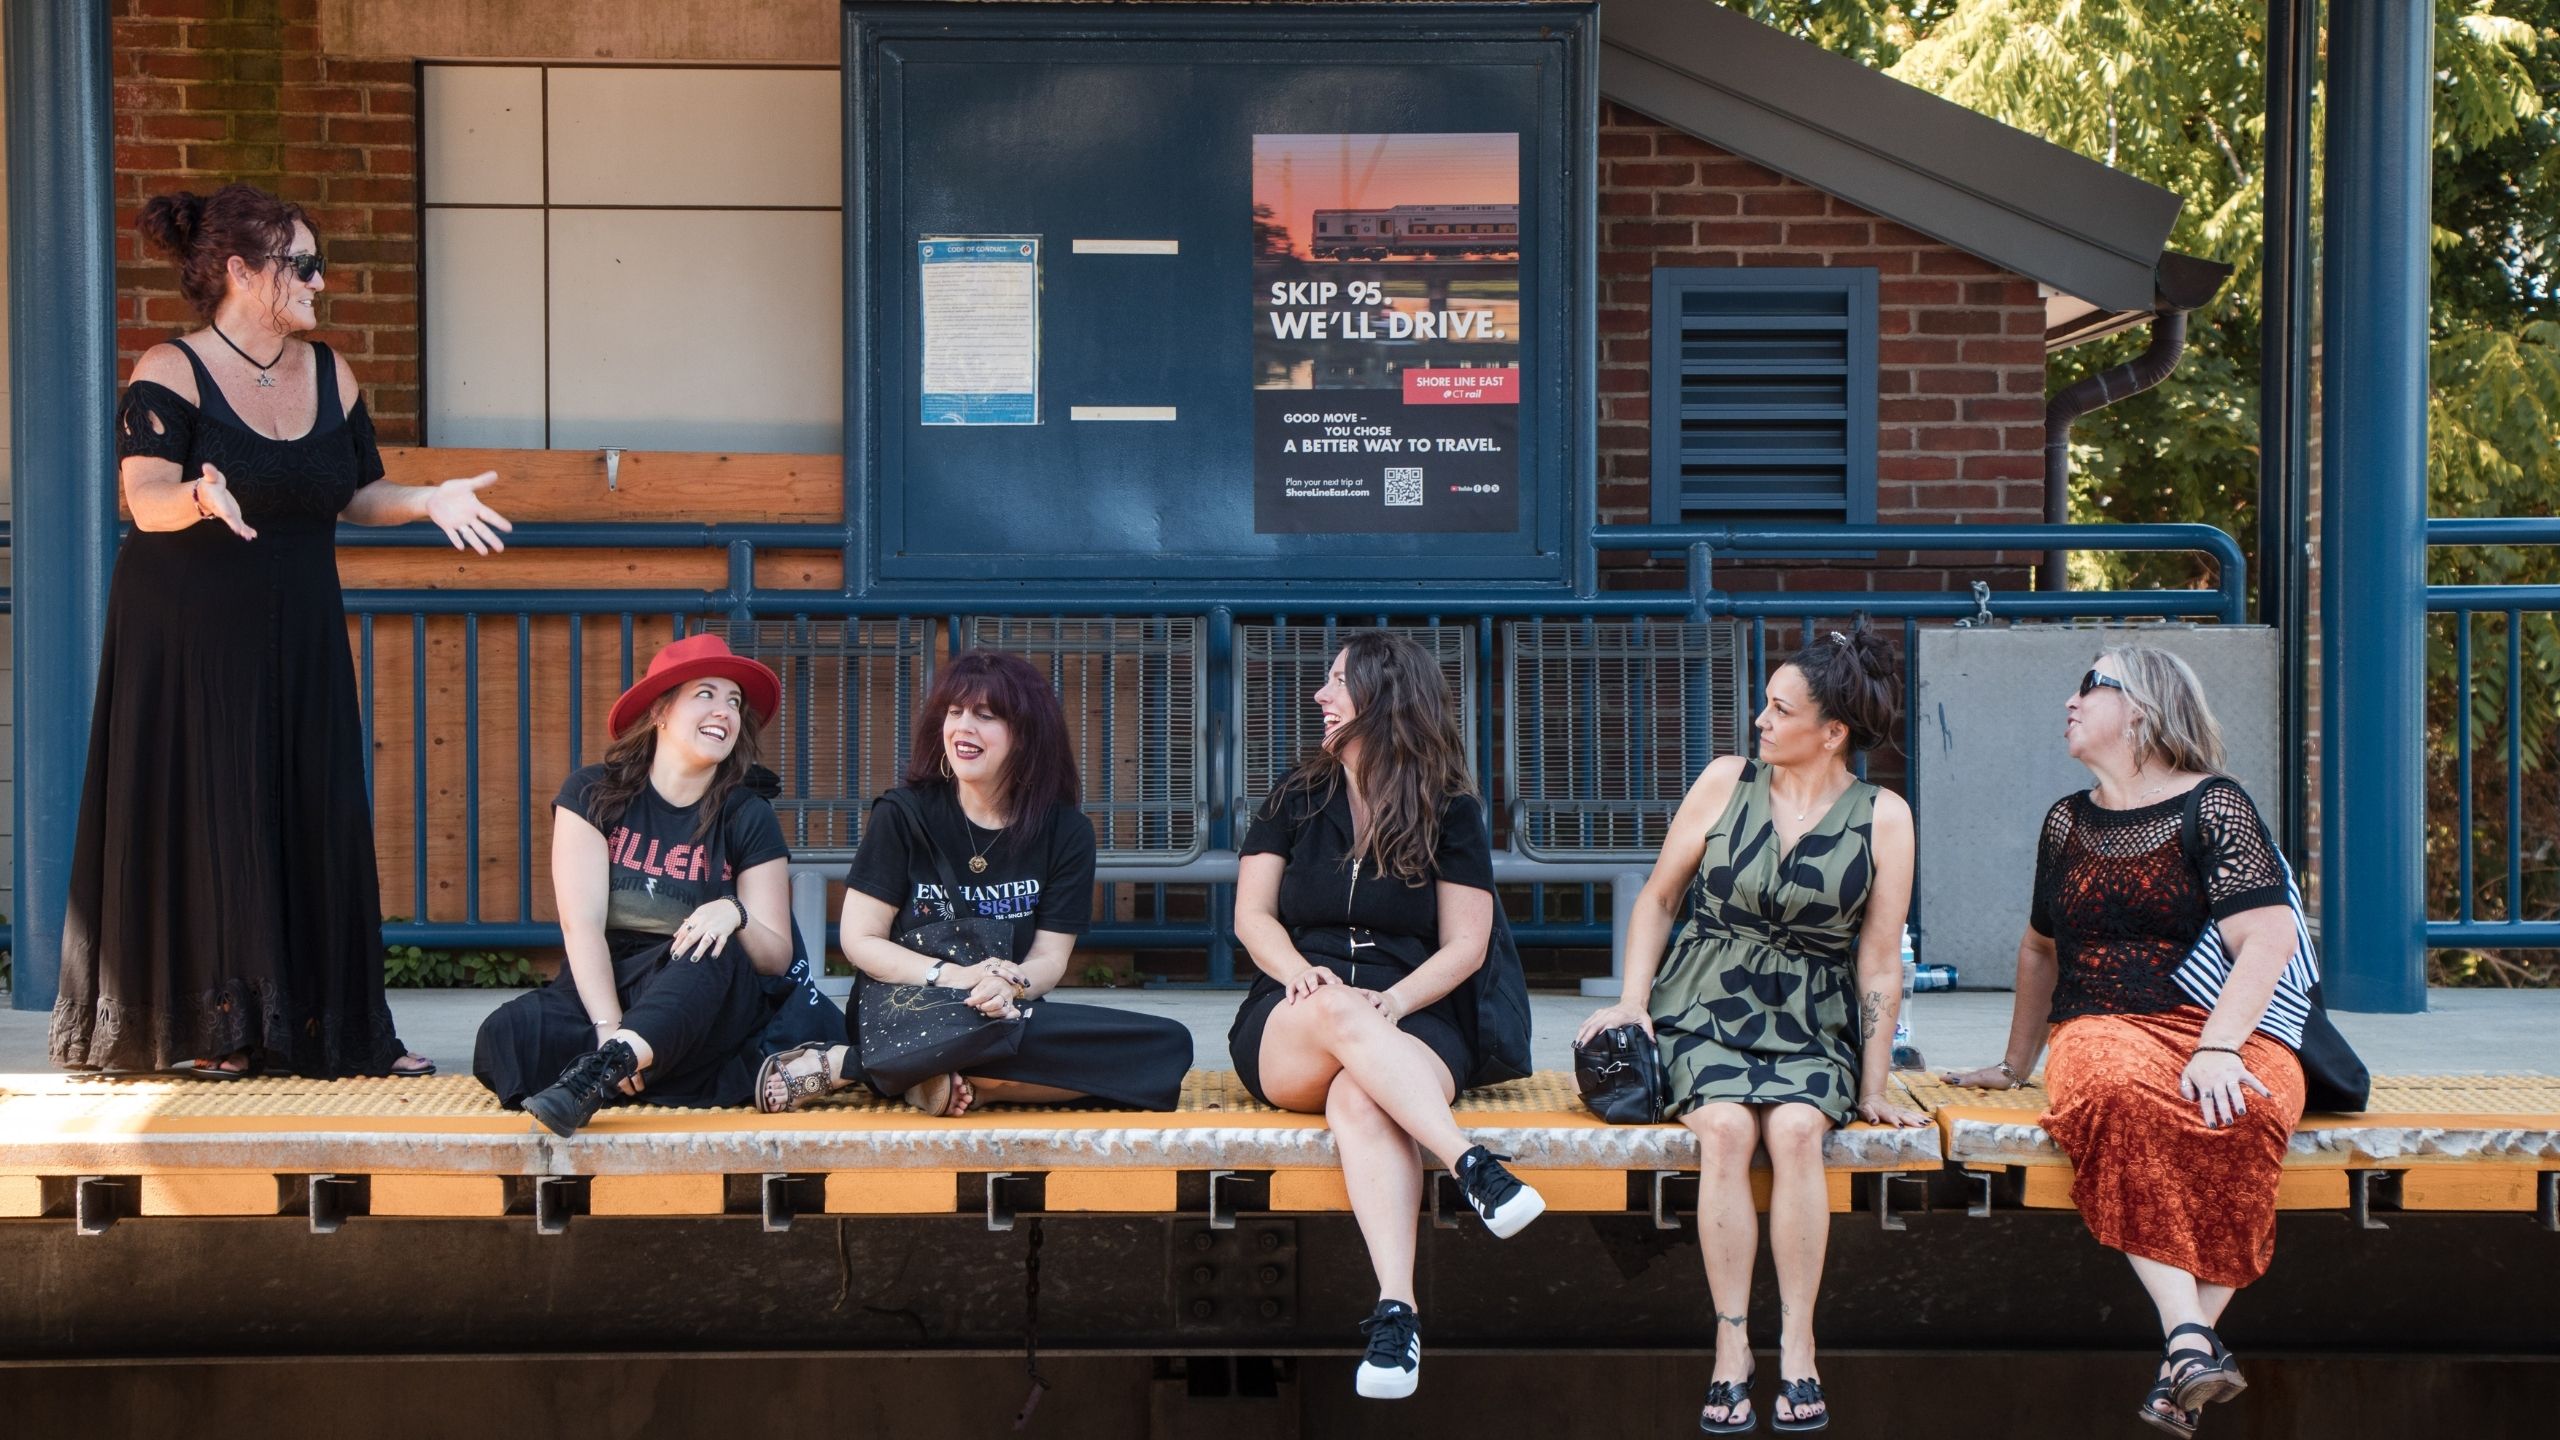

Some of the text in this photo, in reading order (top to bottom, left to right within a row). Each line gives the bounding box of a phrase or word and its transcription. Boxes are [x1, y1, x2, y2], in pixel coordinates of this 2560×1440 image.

[1271, 281, 1392, 305] SKIP 95.
[1389, 310, 1505, 339] DRIVE.
[1416, 376, 1504, 387] SHORE LINE EAST
[1283, 413, 1320, 423] GOOD
[1323, 413, 1357, 423] MOVE
[1324, 426, 1391, 436] YOU CHOSE
[1283, 438, 1501, 453] A BETTER WAY TO TRAVEL.
[1285, 477, 1363, 488] Plan your next trip at
[1285, 488, 1370, 497] ShoreLineEast.com
